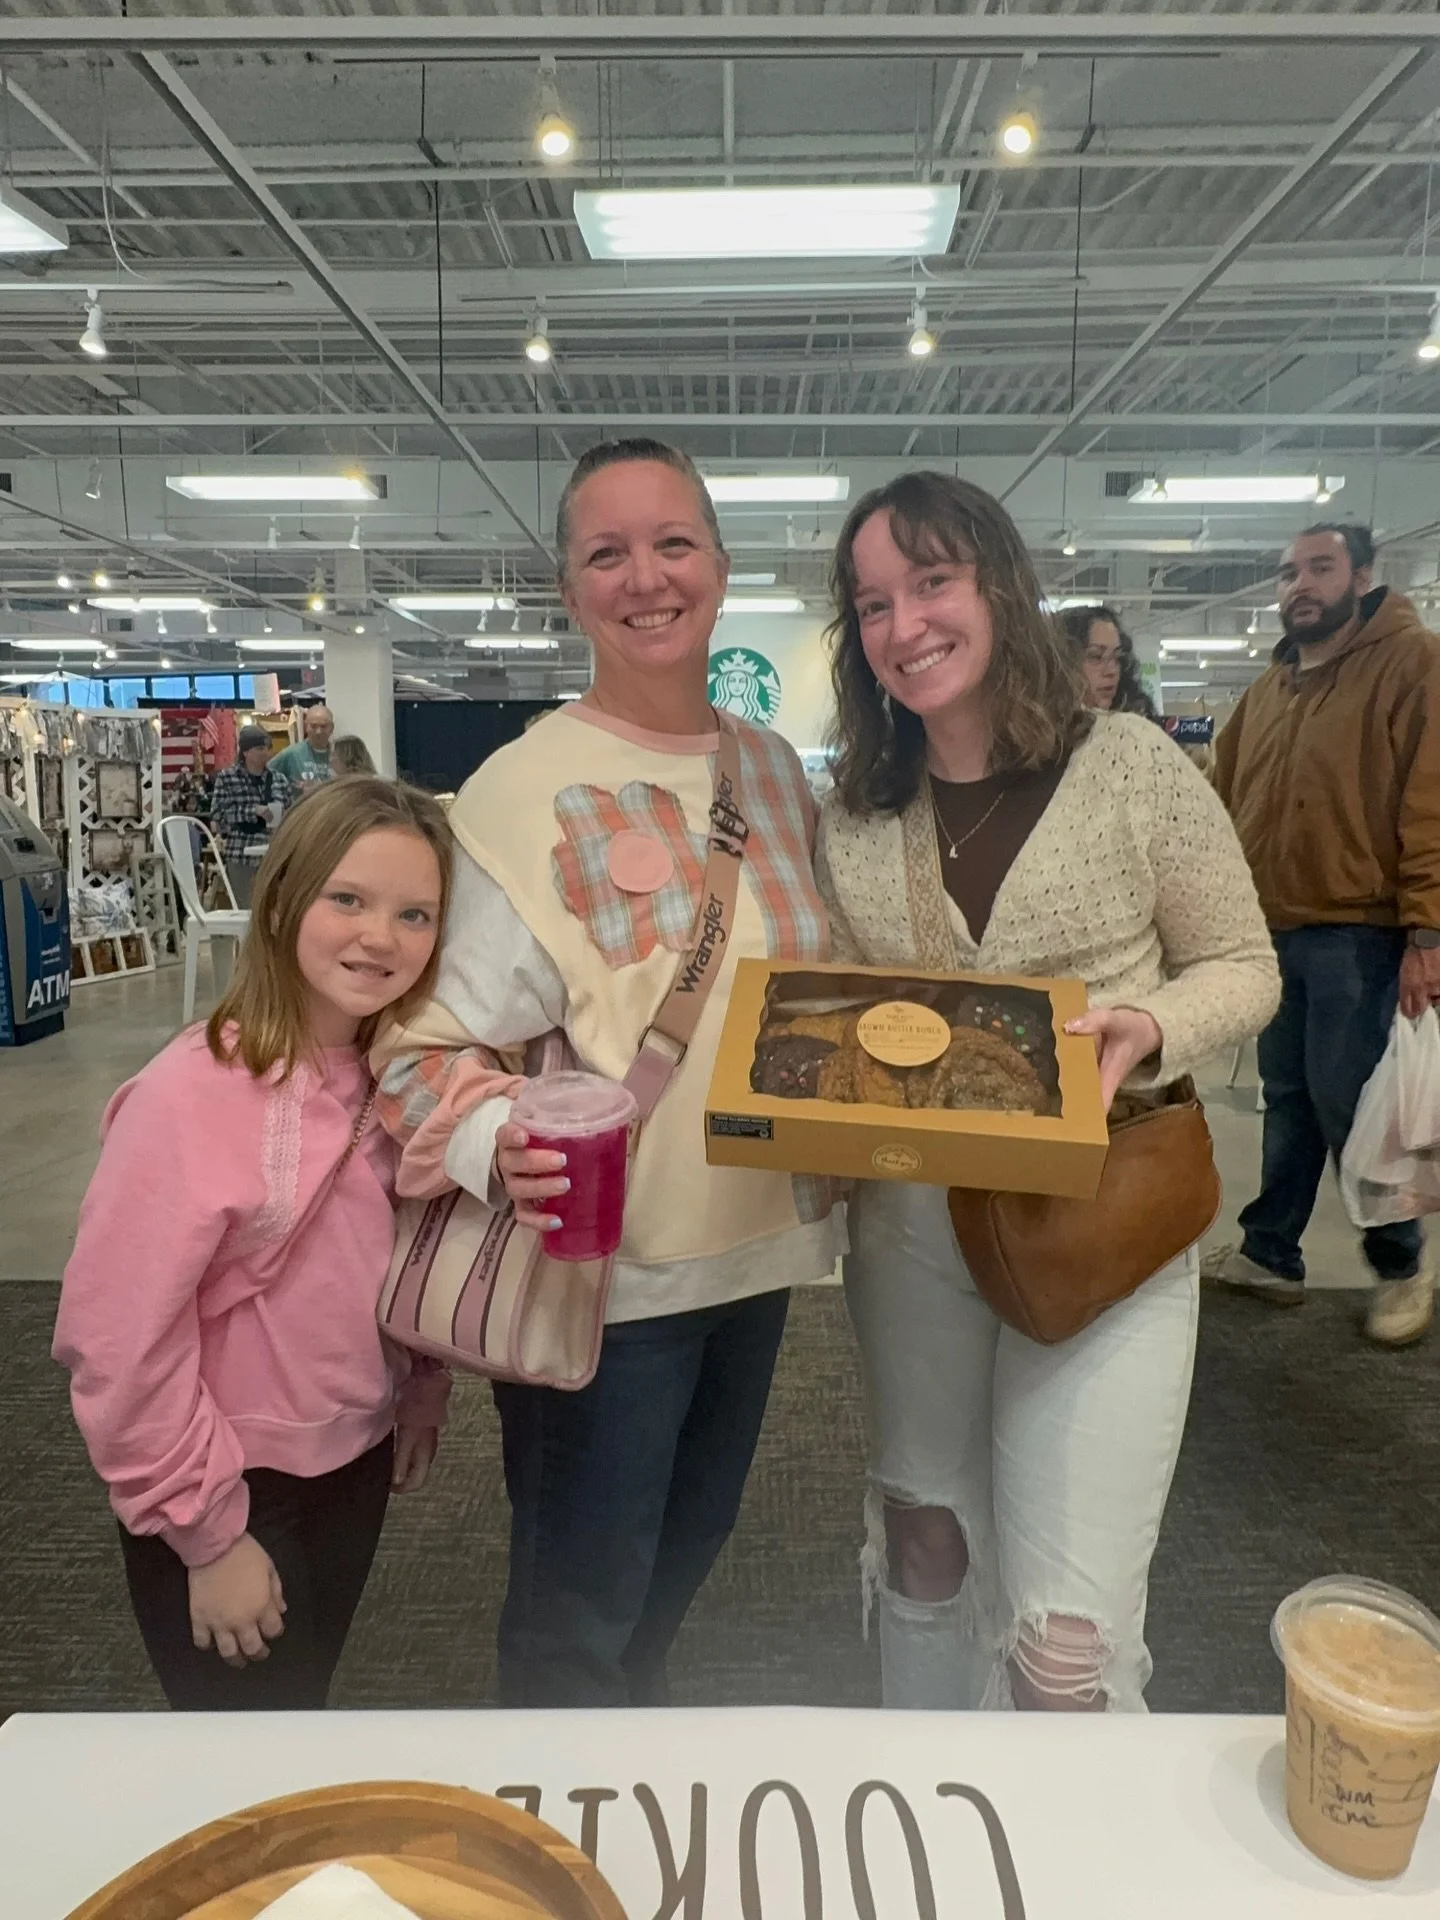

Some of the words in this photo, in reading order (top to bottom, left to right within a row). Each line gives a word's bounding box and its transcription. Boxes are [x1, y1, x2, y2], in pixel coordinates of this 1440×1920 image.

[1180, 721, 1208, 735] pepsi
[676, 893, 727, 994] Wrangler
[27, 970, 70, 1009] ATM
